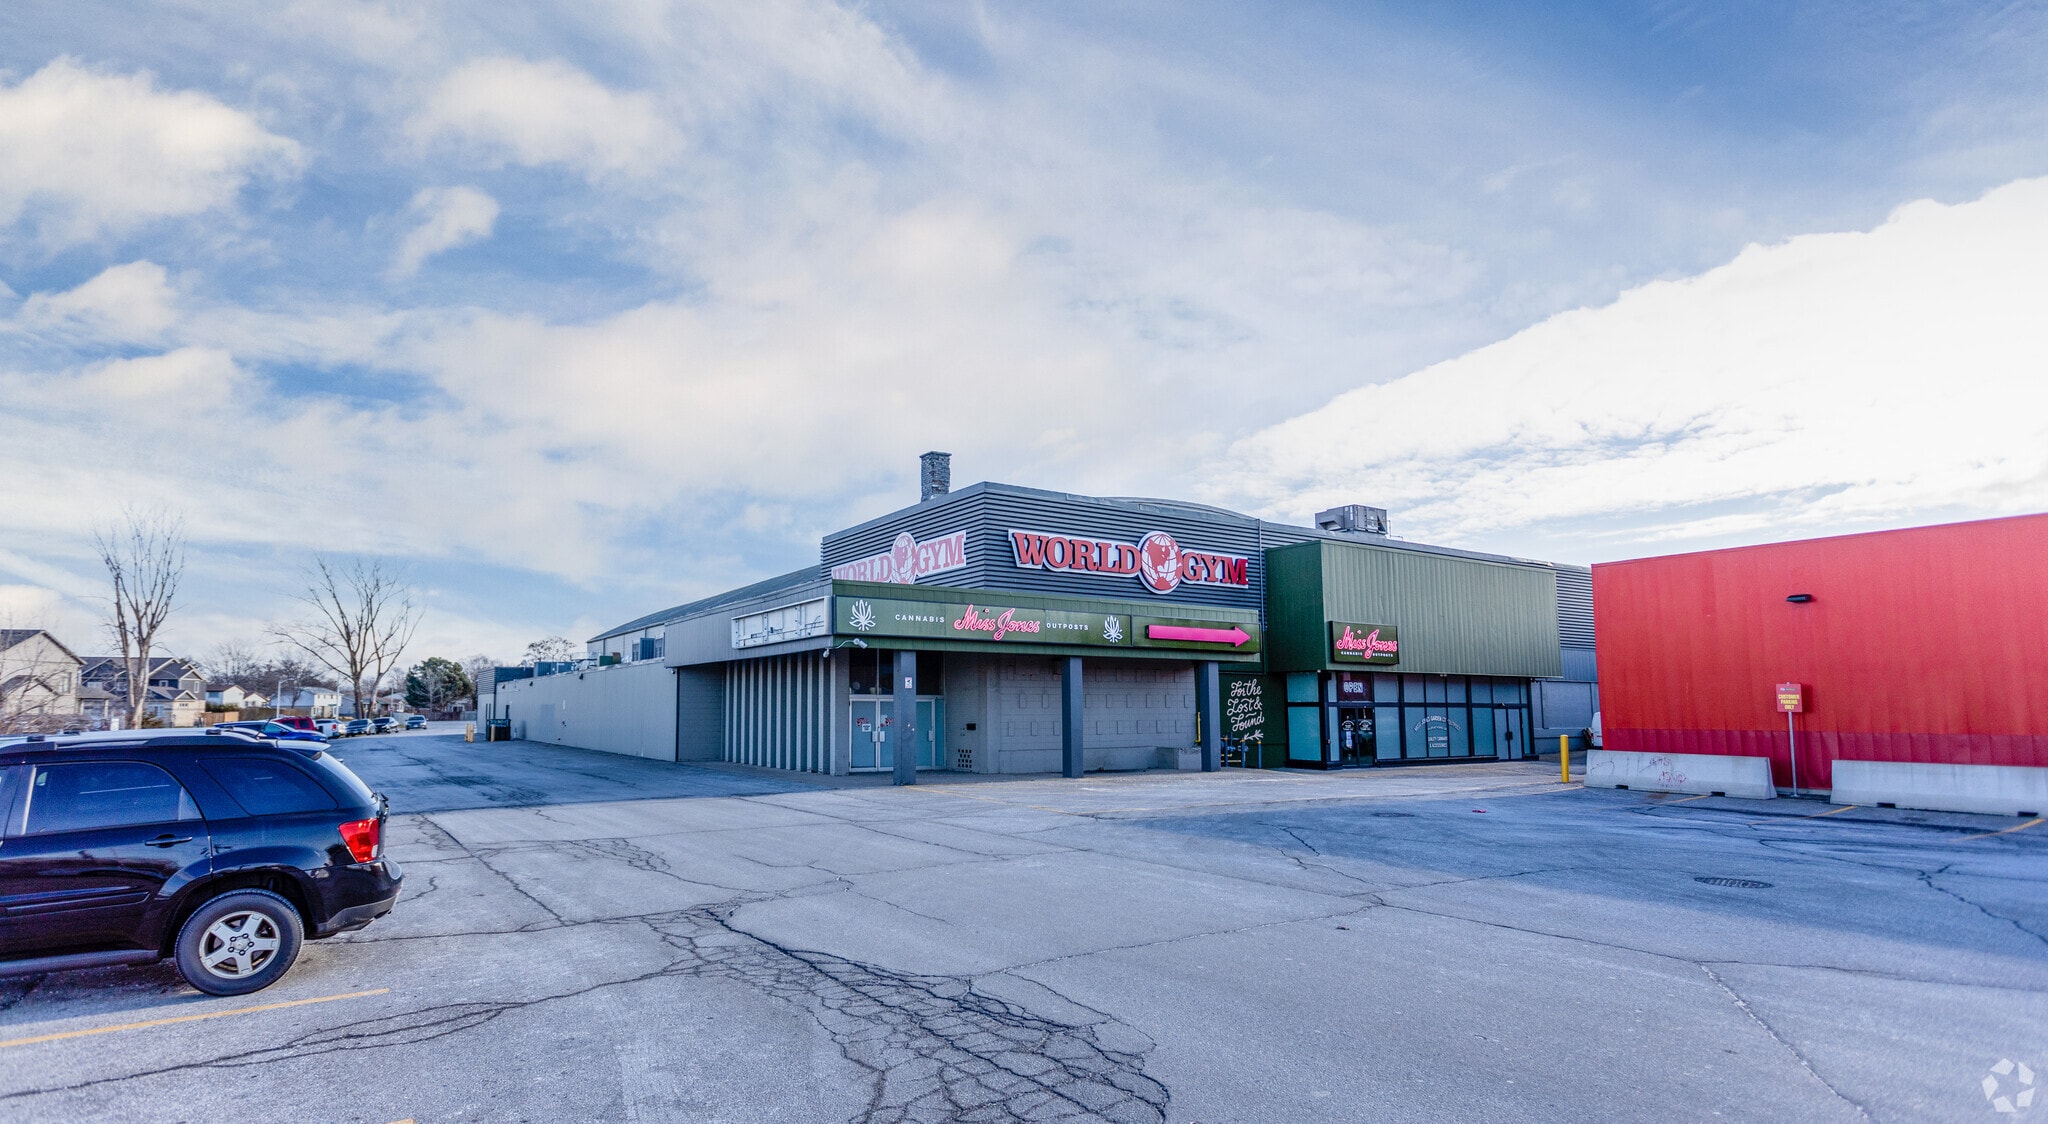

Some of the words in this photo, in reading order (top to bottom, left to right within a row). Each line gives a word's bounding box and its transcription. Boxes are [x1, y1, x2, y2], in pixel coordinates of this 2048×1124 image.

[832, 555, 892, 583] WORLD
[916, 534, 965, 575] GYM
[1013, 532, 1141, 575] WORLD
[1183, 551, 1249, 586] GYM
[895, 613, 945, 623] CANNABIS
[953, 604, 995, 632] Miss
[993, 607, 1040, 641] Jones
[1046, 622, 1089, 631] OUTPOSTS
[1336, 625, 1366, 650] Miss
[1364, 629, 1398, 659] Jones
[1243, 679, 1262, 696] the
[1344, 681, 1363, 693] OPEN
[1227, 698, 1255, 716] Lost
[1231, 711, 1264, 732] Found
